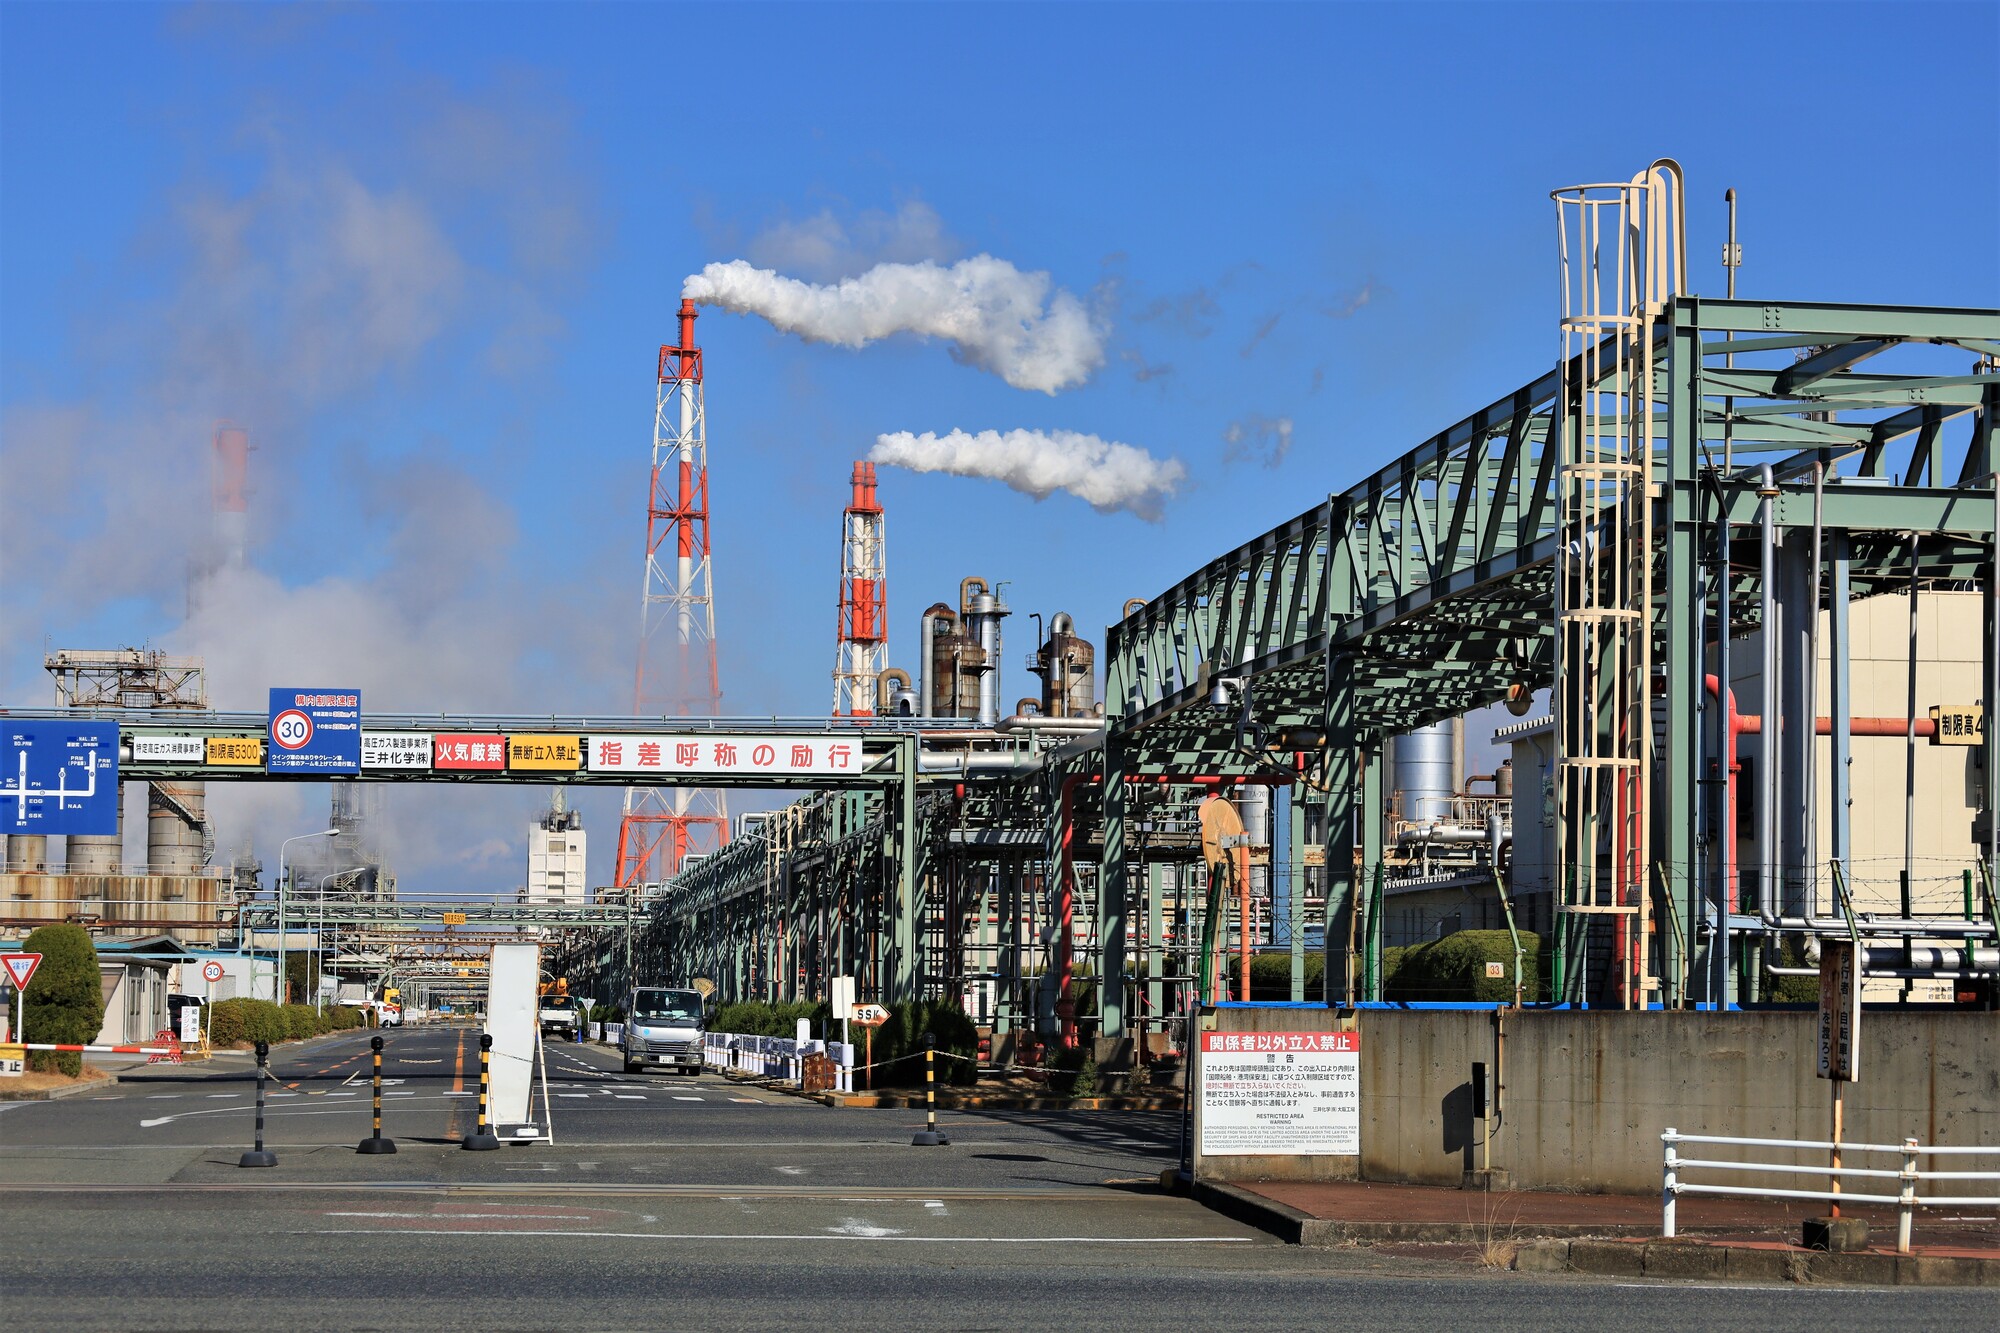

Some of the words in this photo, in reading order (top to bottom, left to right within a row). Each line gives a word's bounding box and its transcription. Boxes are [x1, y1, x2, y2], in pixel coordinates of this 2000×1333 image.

[295, 694, 357, 707] 構内制限速度
[281, 721, 305, 738] 30
[136, 743, 200, 754] 特定高圧ガス消費事業所
[364, 737, 428, 749] 高圧ガス製造事業所
[209, 744, 258, 759] 制限高5300
[437, 742, 502, 762] 火気厳禁
[512, 745, 577, 761] 無断立入禁止
[599, 741, 852, 768] 指差呼称の励行
[12, 961, 30, 970] 徐行
[206, 967, 219, 976] 30
[1490, 965, 1500, 975] 33
[857, 1008, 879, 1020] SSK
[1838, 951, 1849, 1071] 歩行者・自転車は
[1209, 1035, 1351, 1051] 関係者以外立入禁止
